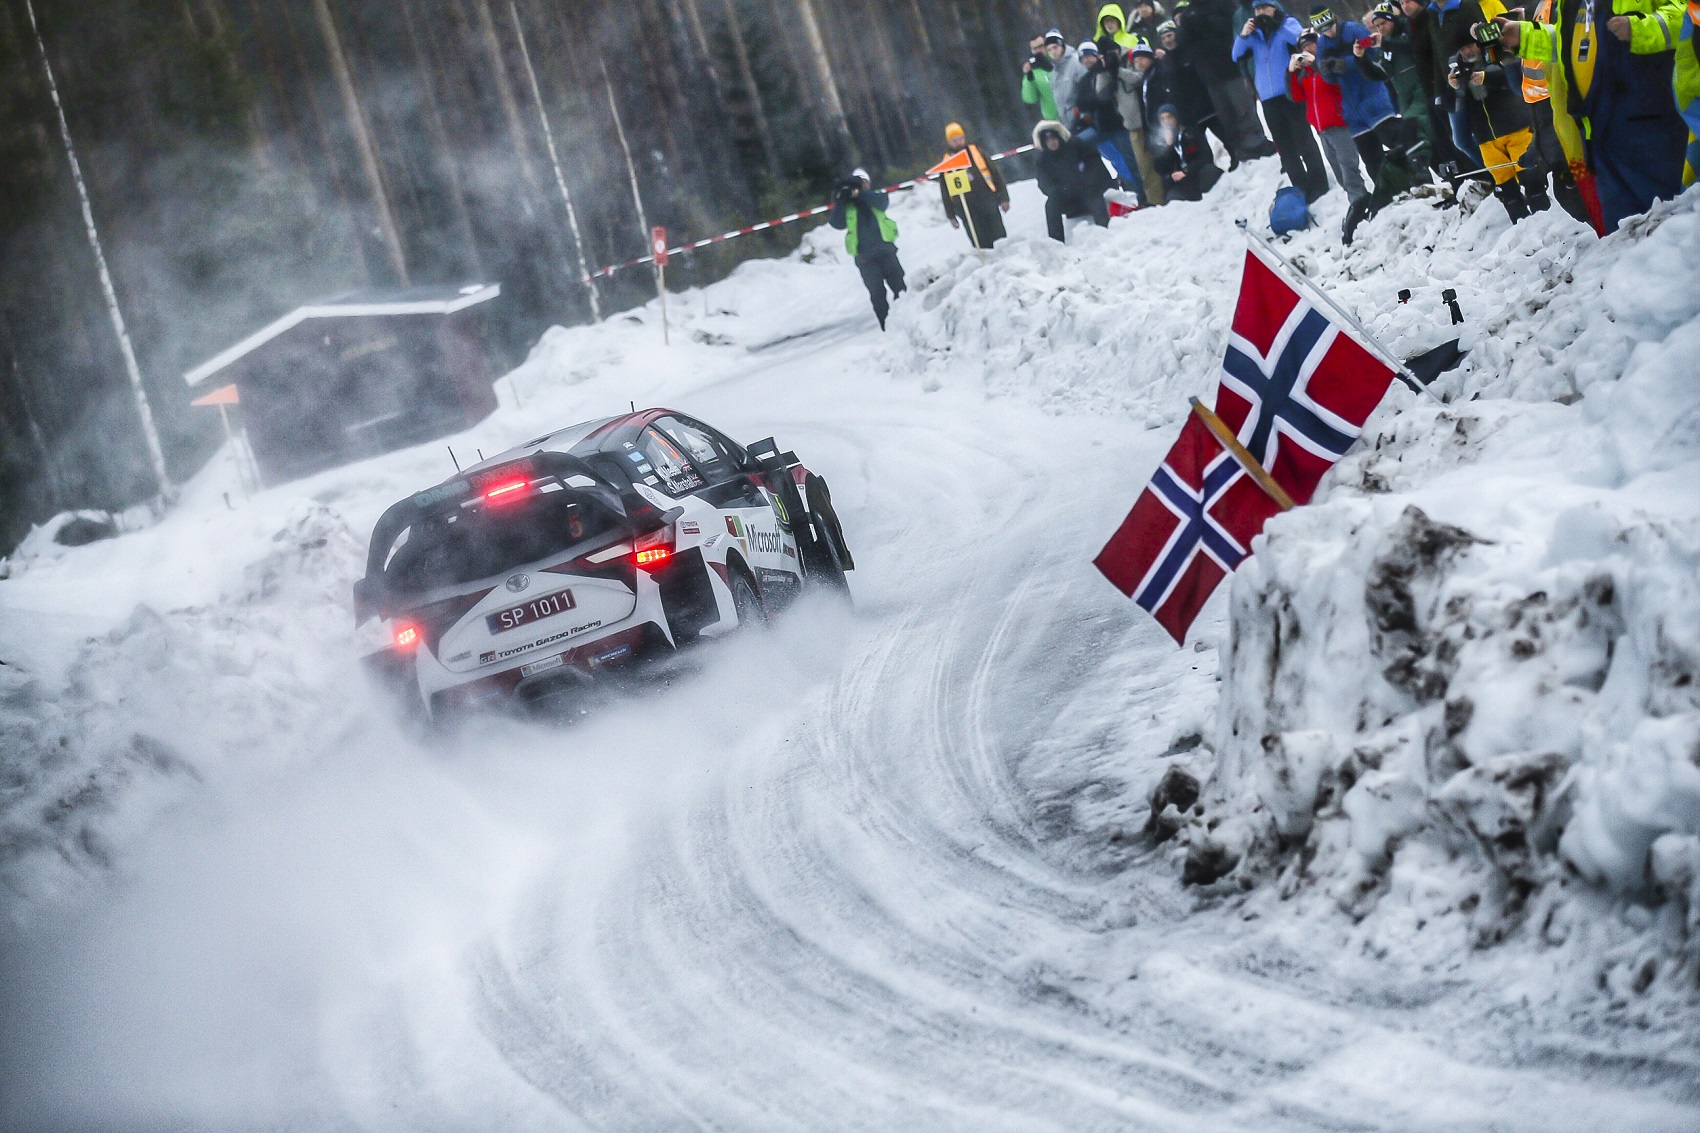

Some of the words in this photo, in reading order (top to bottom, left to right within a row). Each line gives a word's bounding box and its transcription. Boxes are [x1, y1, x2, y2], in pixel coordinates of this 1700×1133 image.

[953, 176, 963, 189] 6
[568, 513, 584, 538] 5
[500, 608, 524, 629] SP
[529, 592, 572, 619] 1011
[498, 643, 534, 658] TOYOTA
[570, 619, 602, 635] Racing
[532, 657, 562, 672] Microsoft
